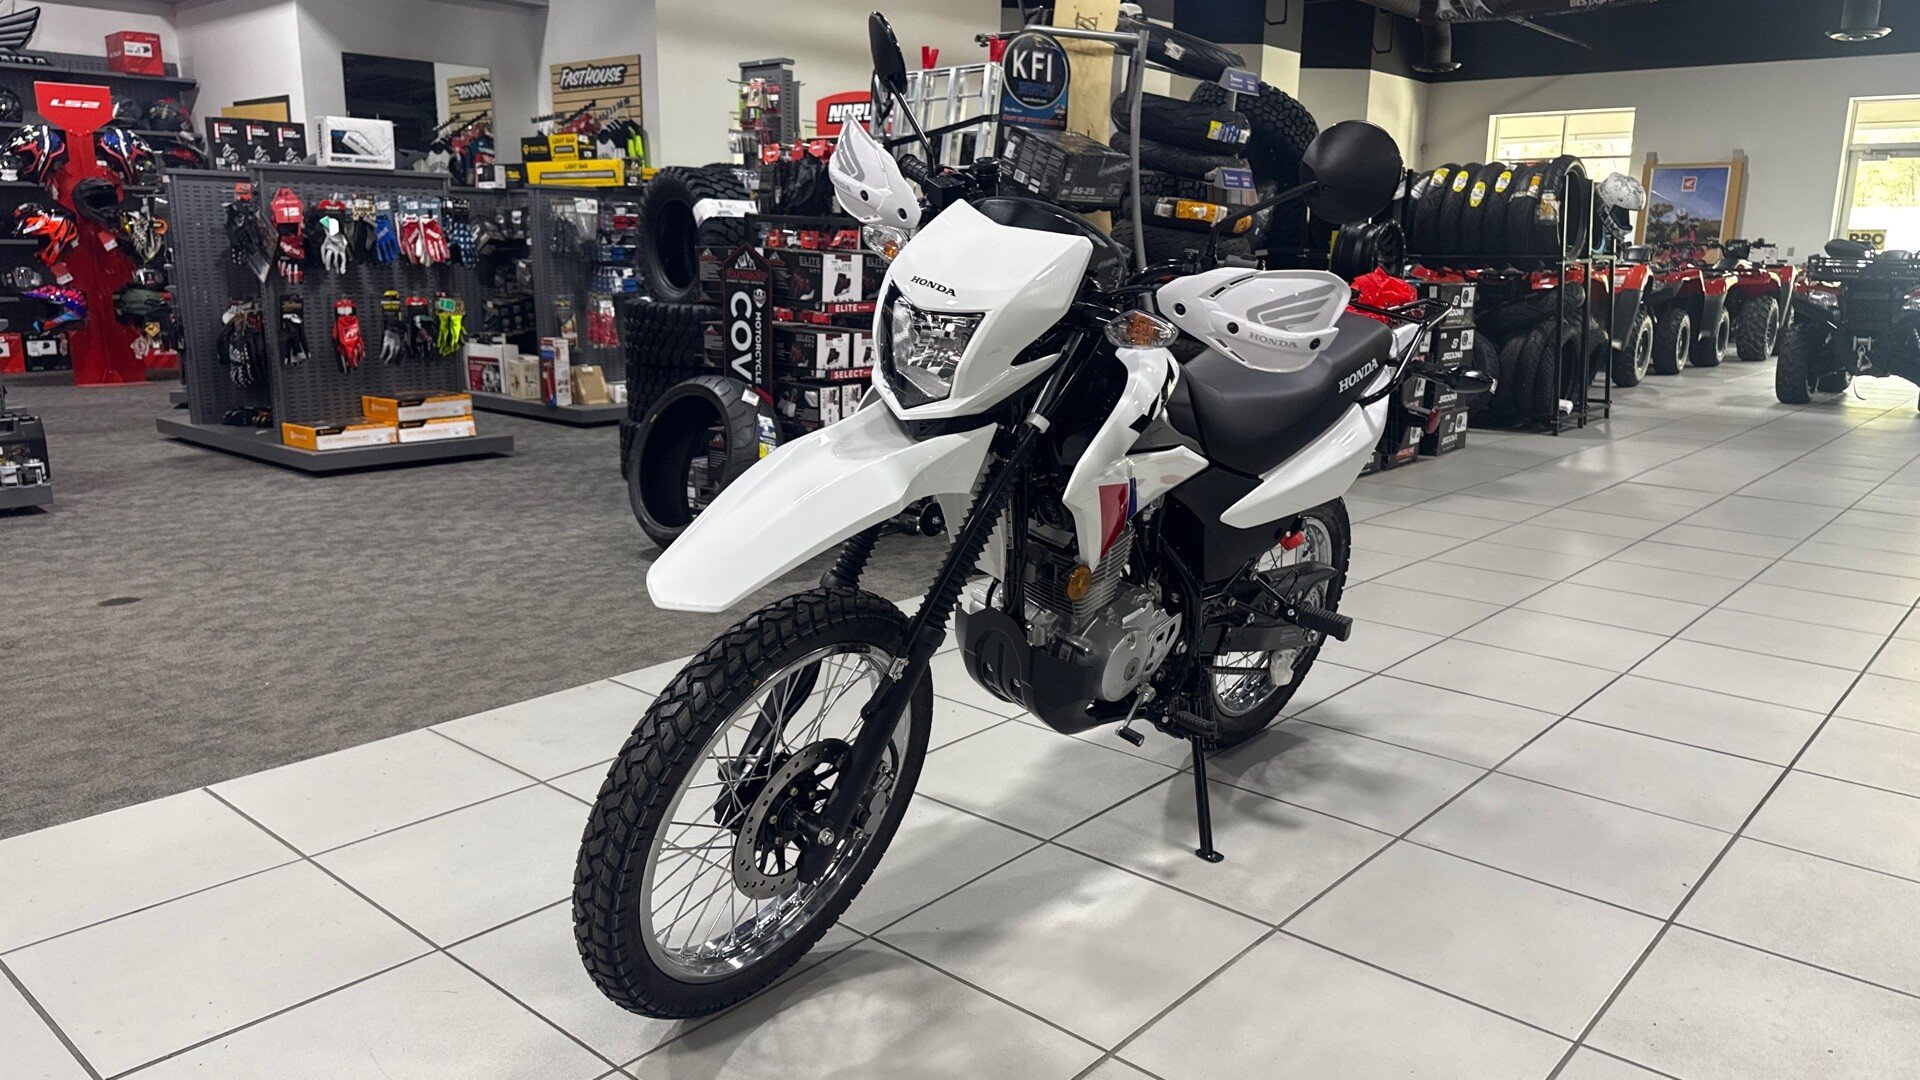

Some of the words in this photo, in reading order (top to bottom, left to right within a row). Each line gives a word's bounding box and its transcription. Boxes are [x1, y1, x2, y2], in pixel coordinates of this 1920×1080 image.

[1012, 48, 1053, 82] KFI
[560, 66, 625, 87] FASTHOUSE
[50, 98, 101, 109] LS2
[1071, 186, 1096, 195] AS-25
[911, 275, 956, 298] HONDA
[835, 304, 858, 312] ELITE
[1250, 332, 1298, 348] HONDA
[834, 370, 863, 379] SELECT
[1338, 357, 1379, 393] HONDA
